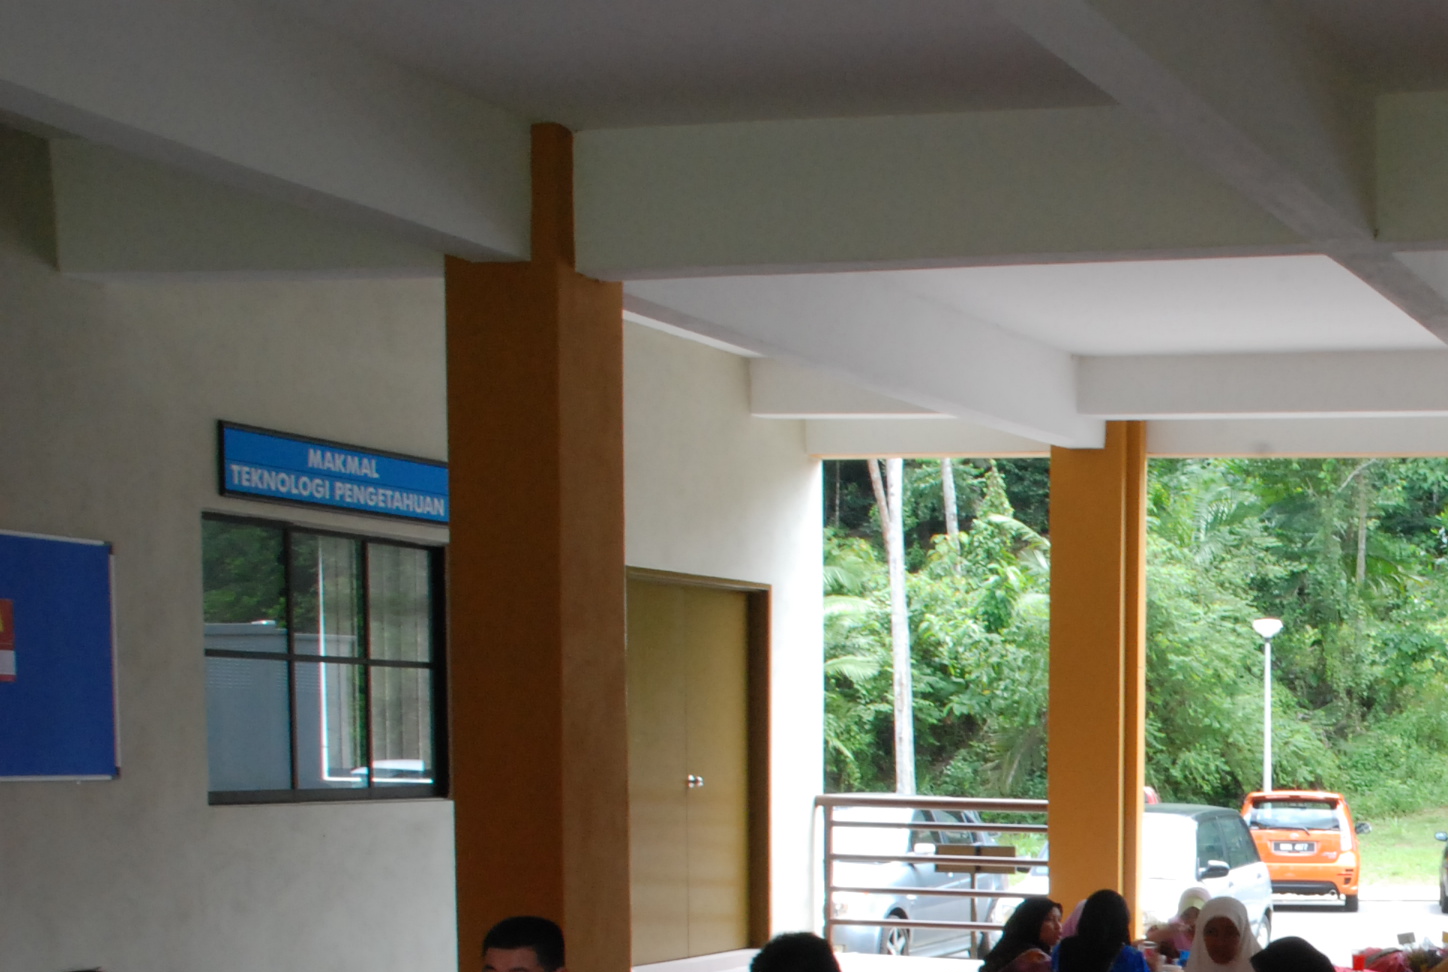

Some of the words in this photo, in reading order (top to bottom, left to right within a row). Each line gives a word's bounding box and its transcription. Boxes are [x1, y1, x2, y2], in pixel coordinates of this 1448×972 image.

[308, 448, 380, 479] MAKMAL
[230, 464, 330, 499] TEKNOLOGI
[334, 481, 445, 517] PENGETAHUAN
